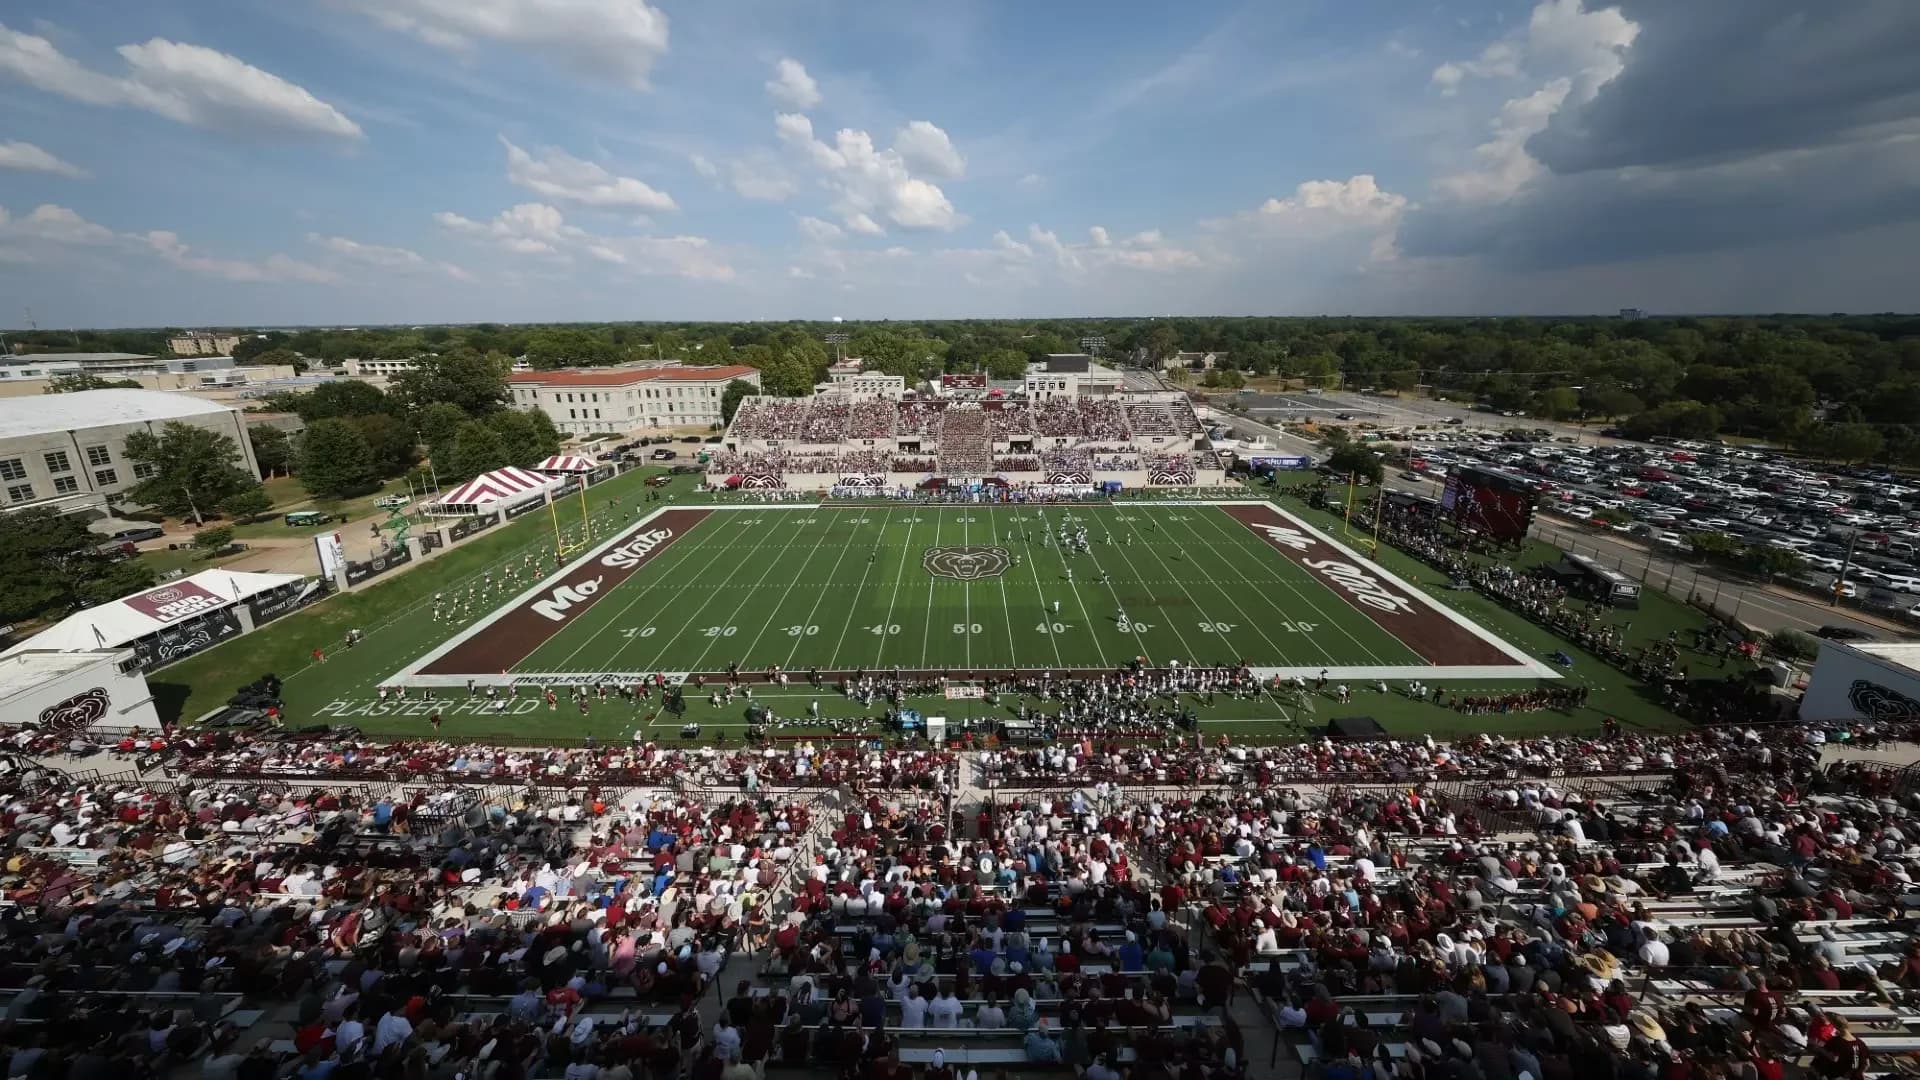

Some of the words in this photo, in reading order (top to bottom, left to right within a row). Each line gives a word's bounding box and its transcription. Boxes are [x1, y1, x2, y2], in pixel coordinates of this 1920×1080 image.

[530, 575, 603, 621] Mo
[600, 527, 672, 569] State
[1302, 557, 1417, 615] State
[156, 596, 204, 613] BUD
[157, 597, 222, 621] LIGHT
[623, 627, 656, 637] 10
[704, 626, 738, 637] 20
[788, 625, 819, 635] 30
[871, 624, 901, 635] 40
[953, 624, 983, 634] 50
[1035, 623, 1066, 633] 40
[1118, 623, 1148, 633] 30
[1198, 623, 1230, 633] 20
[1281, 621, 1314, 632] 10
[312, 700, 447, 717] PLASTER
[452, 700, 541, 717] FIELD
